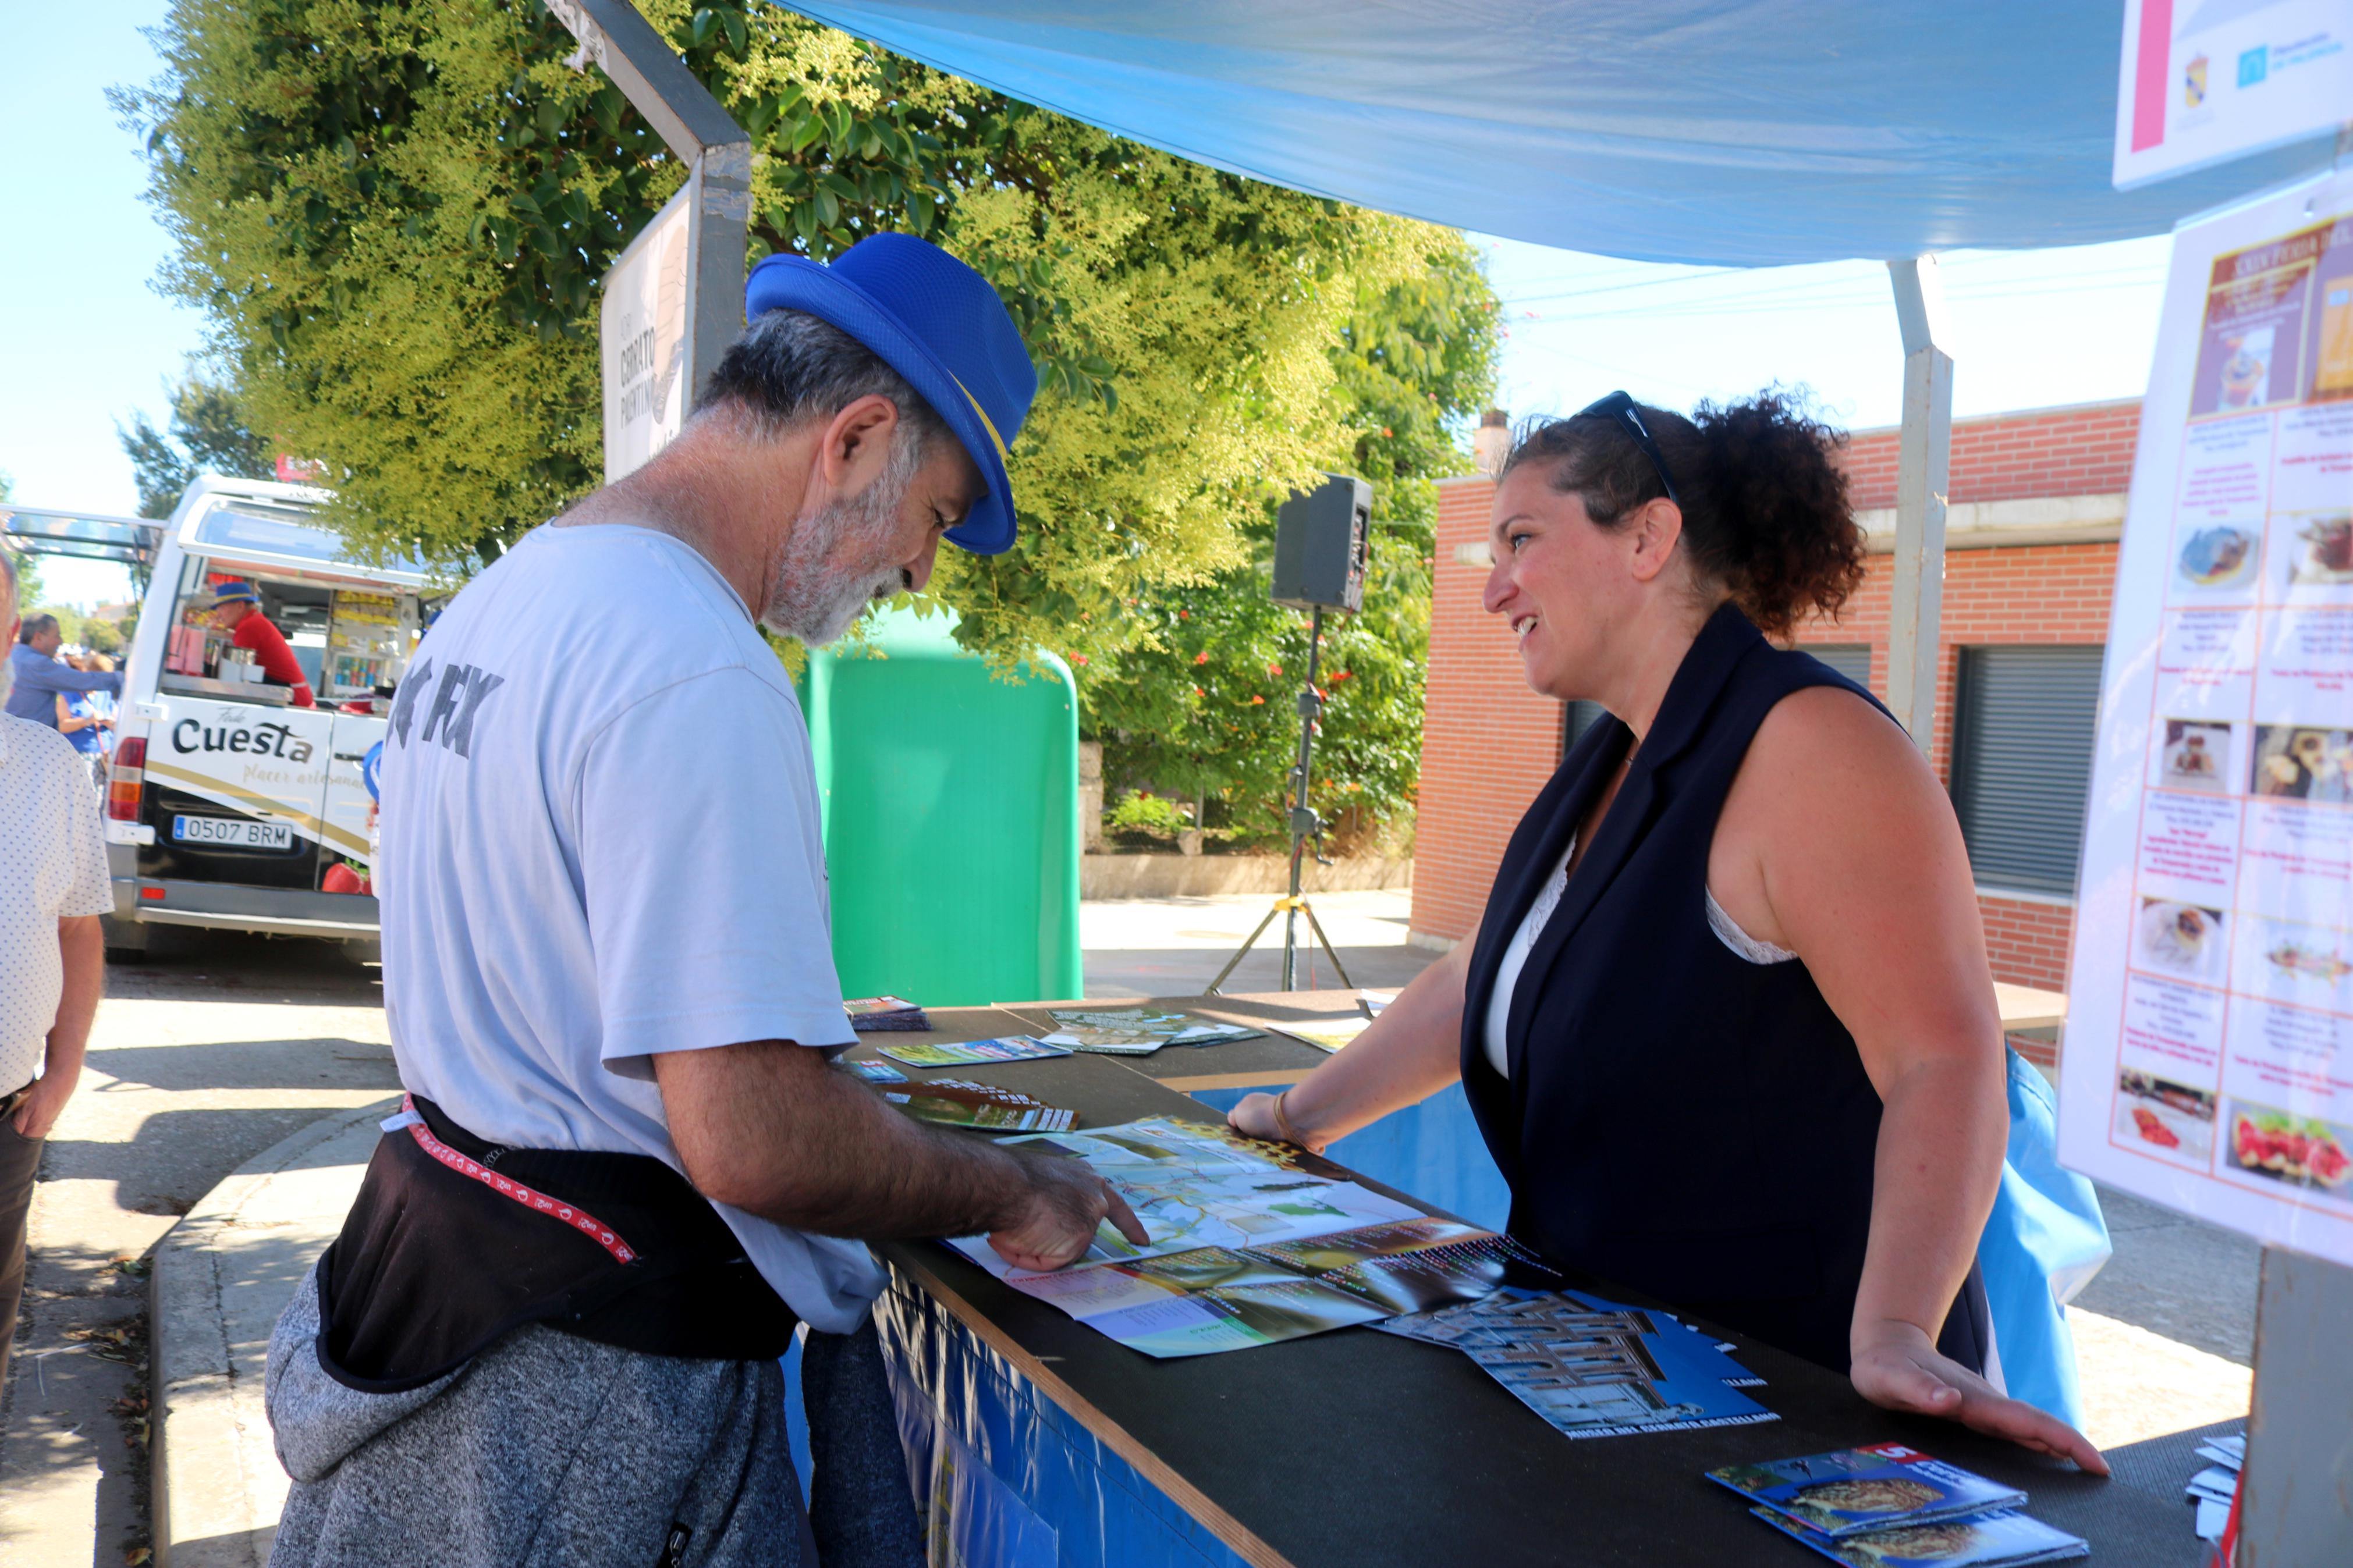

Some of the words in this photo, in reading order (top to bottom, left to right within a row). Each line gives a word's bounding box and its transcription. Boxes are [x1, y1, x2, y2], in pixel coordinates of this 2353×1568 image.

[173, 718, 313, 763] Cuesta
[243, 763, 290, 784] placer
[189, 820, 240, 840] 0507
[248, 825, 286, 844] BRM
[1564, 1427, 1615, 1440] MUSEO
[1615, 1425, 1639, 1436] DEL
[1641, 1420, 1702, 1434] CERRATO
[1701, 1412, 1781, 1428] CASTELLANO
[1875, 1446, 1918, 1458] 5
